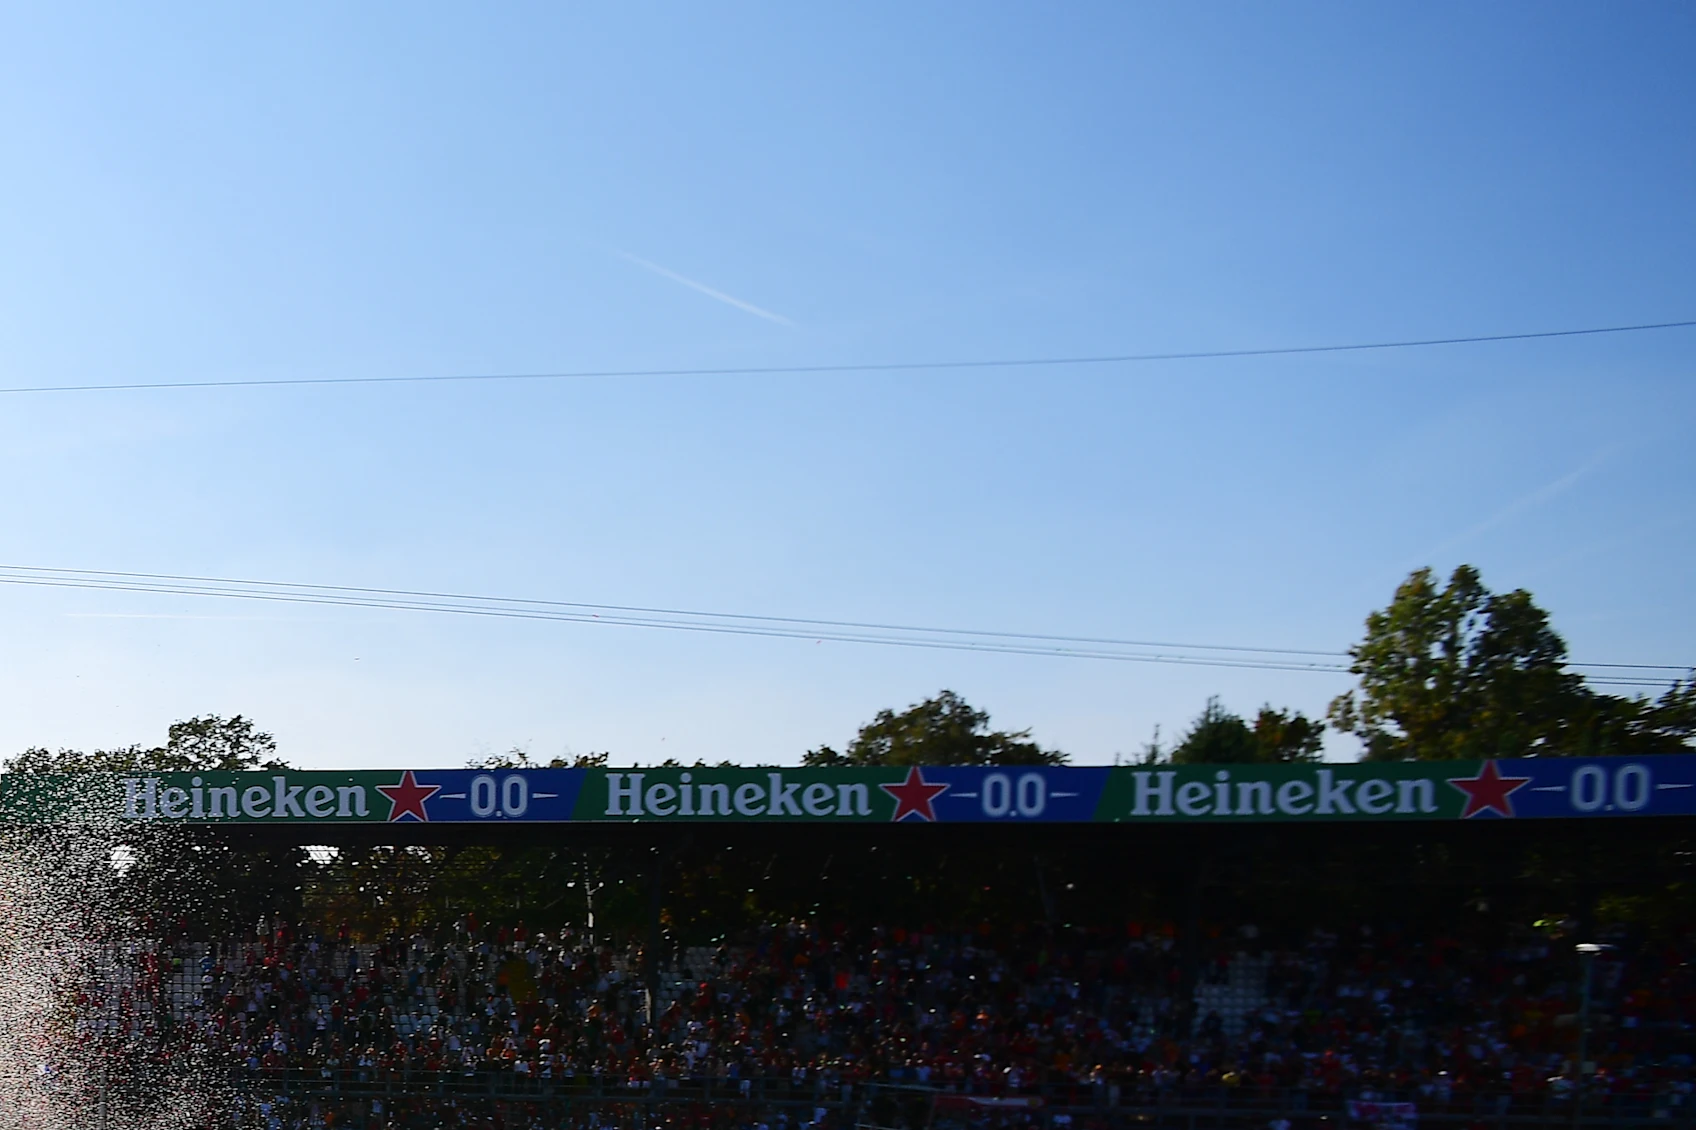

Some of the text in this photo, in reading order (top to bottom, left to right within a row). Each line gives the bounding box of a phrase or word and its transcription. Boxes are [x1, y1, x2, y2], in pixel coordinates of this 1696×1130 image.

[125, 775, 370, 821] Heineken
[605, 772, 873, 818] Heineken
[1130, 769, 1438, 817] Heineken
